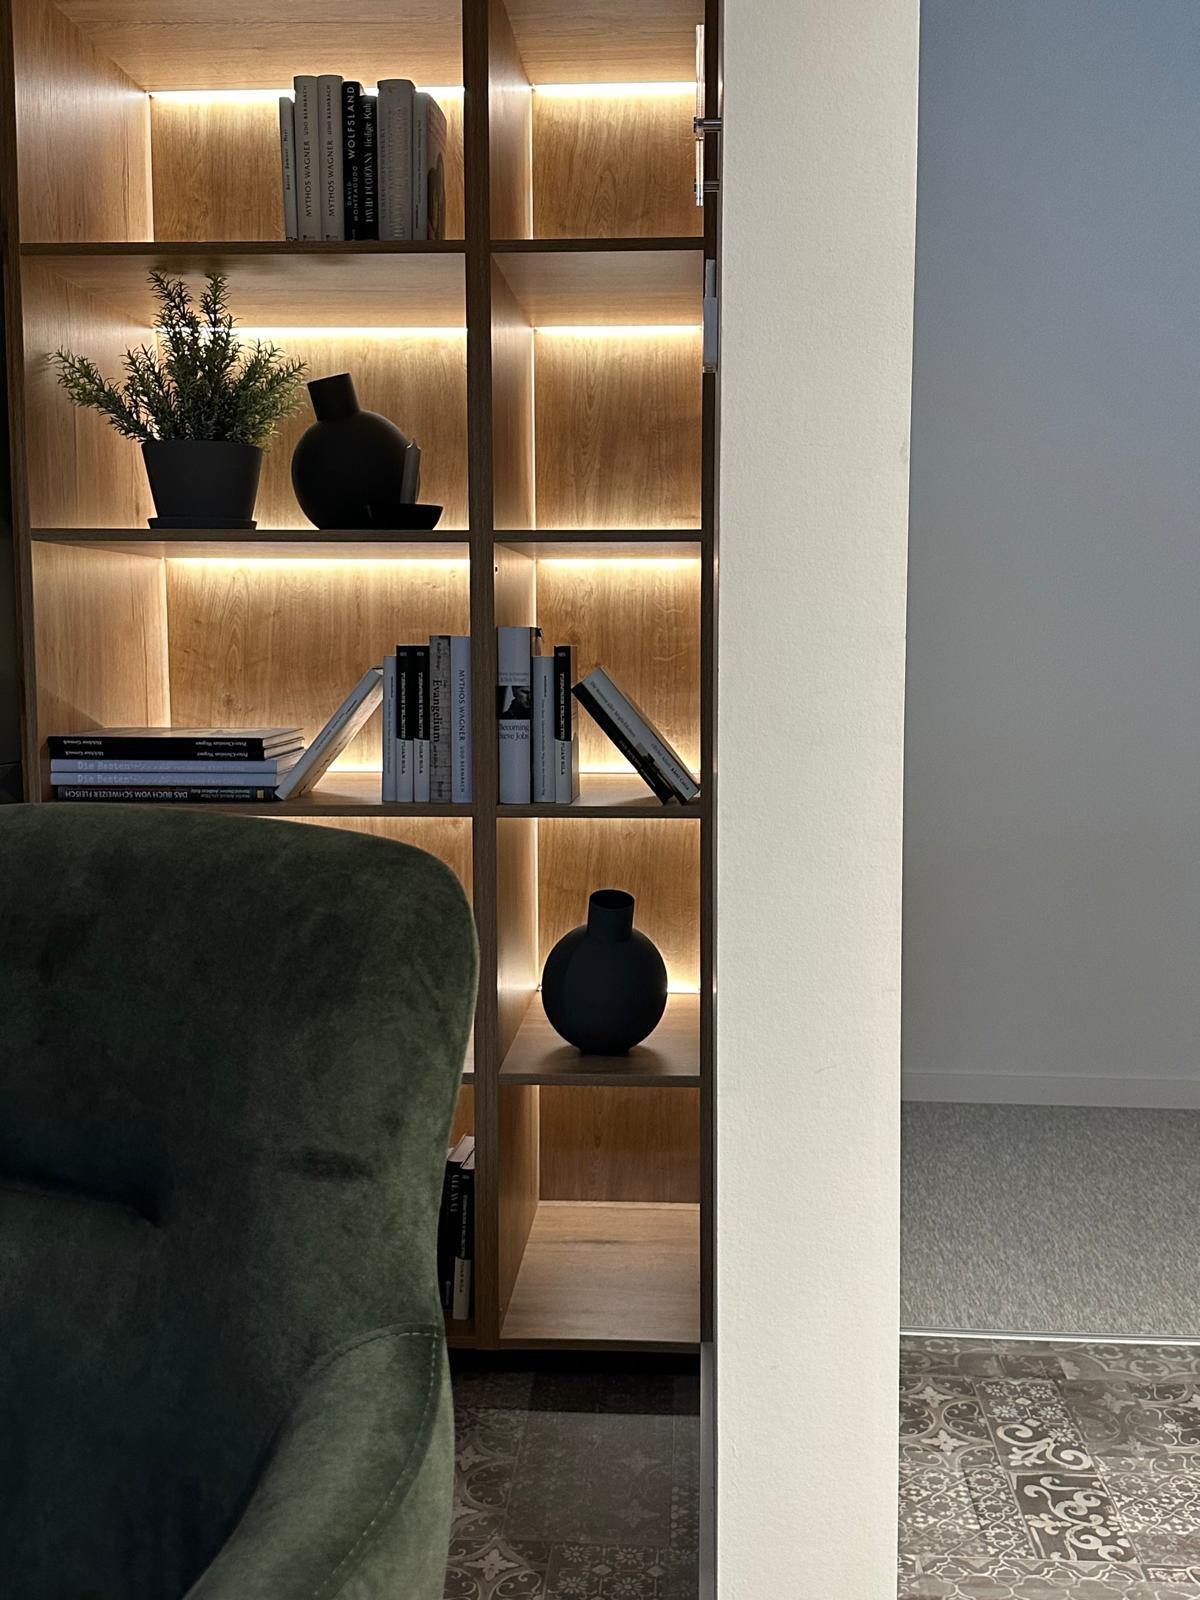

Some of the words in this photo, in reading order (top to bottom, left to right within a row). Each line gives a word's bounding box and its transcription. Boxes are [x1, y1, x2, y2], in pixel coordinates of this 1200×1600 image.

[363, 103, 372, 120] Kuh
[364, 122, 373, 147] Heilige
[303, 140, 311, 179] WAGNER
[328, 180, 336, 217] MYTHOS
[431, 679, 442, 742] Evangelium
[77, 761, 94, 770] Die
[97, 762, 130, 770] Besten
[77, 774, 94, 783] Die
[97, 774, 130, 783] Besten
[65, 790, 92, 798] FLEISCH
[94, 790, 134, 798] SCHWEIZER
